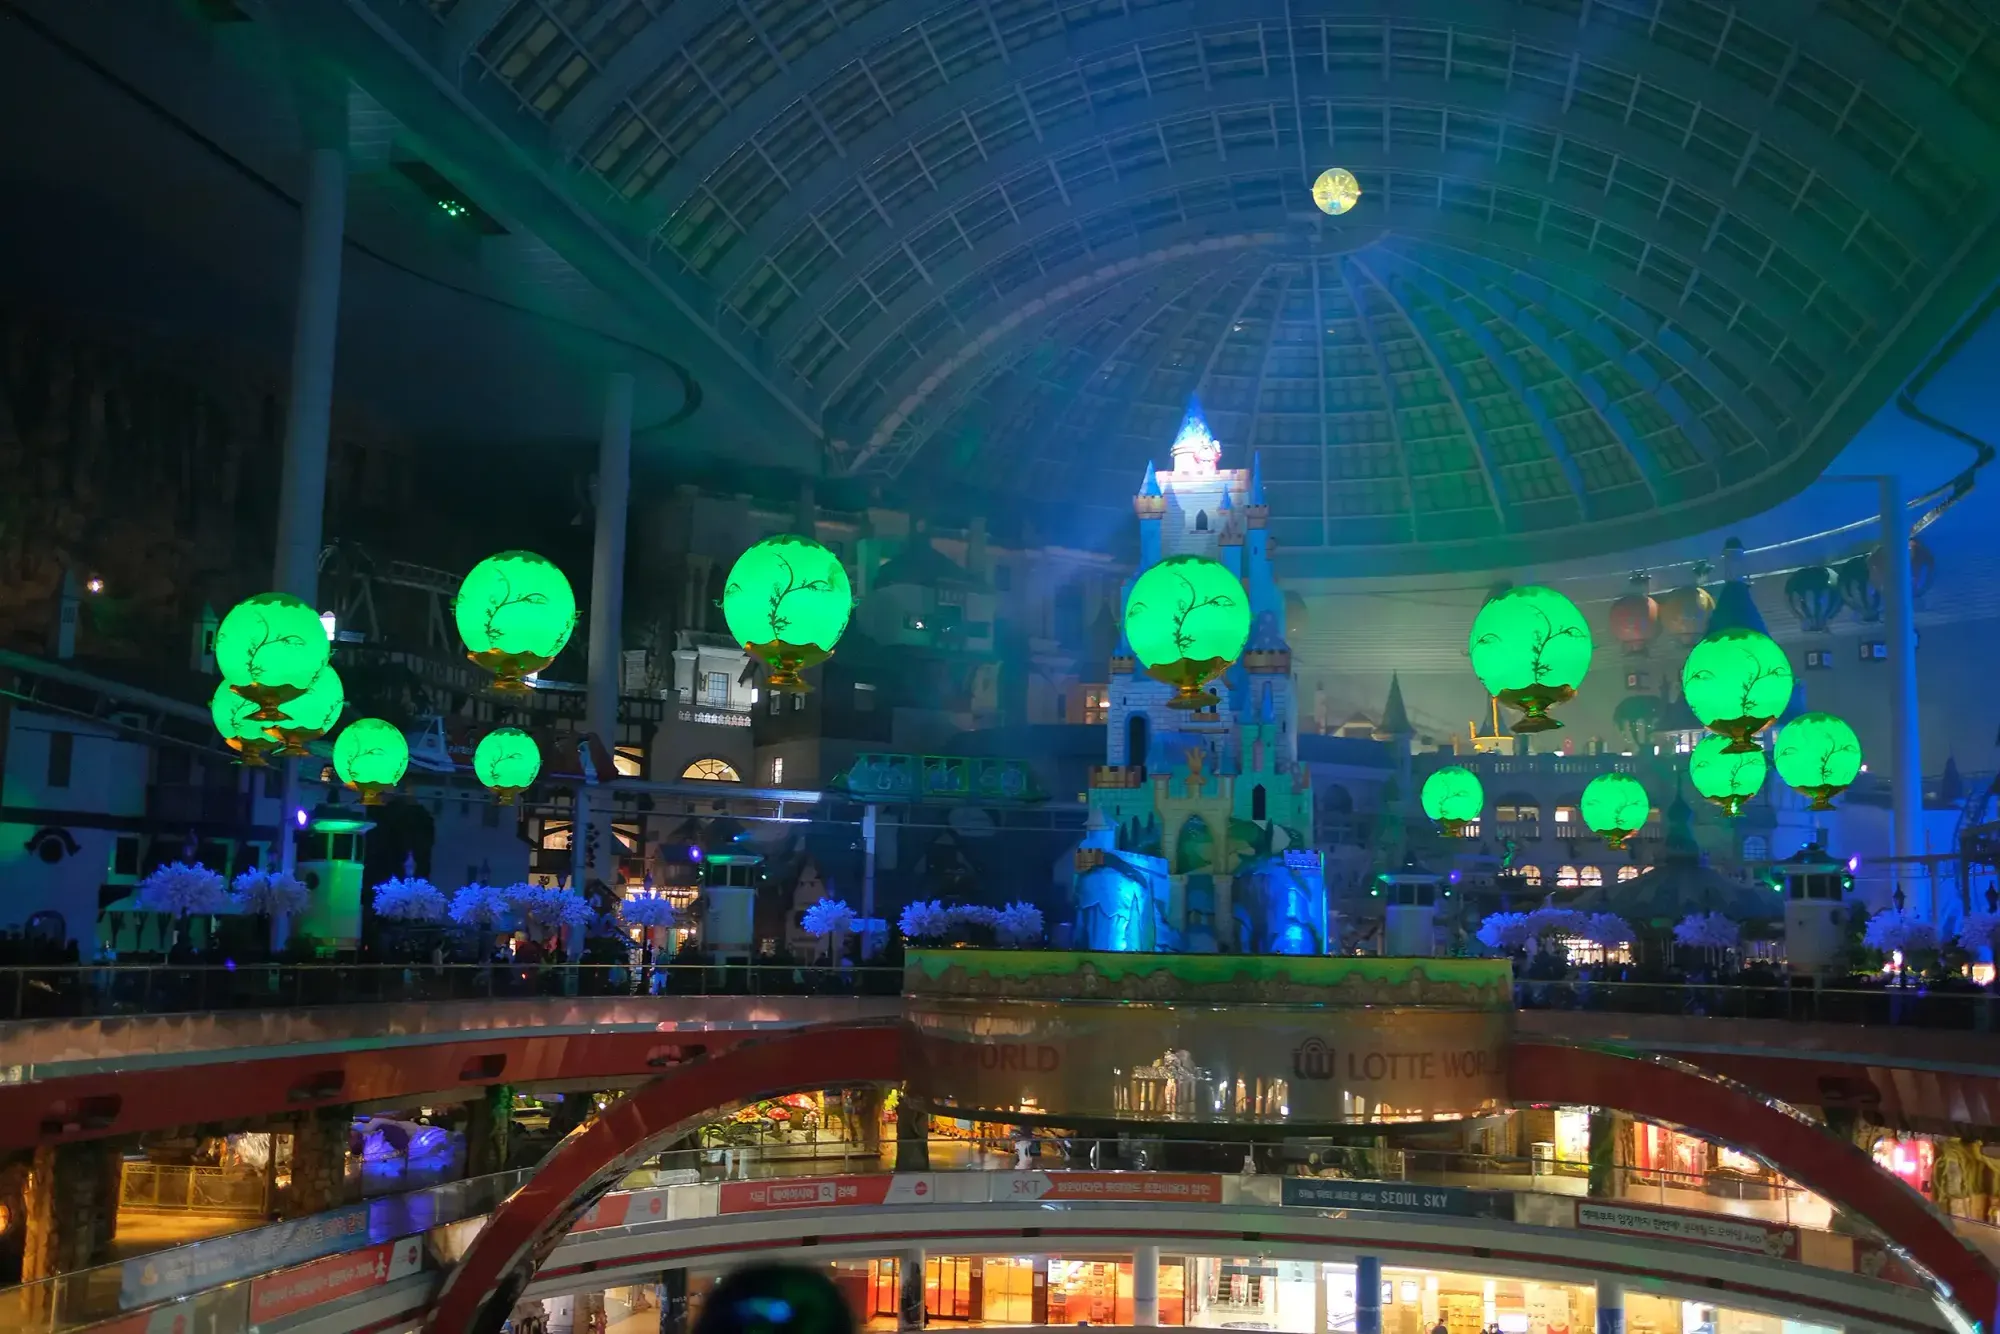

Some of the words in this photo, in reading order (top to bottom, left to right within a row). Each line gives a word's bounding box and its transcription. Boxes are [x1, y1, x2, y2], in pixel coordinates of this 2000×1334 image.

[1346, 1051, 1435, 1081] LOTTE
[1442, 1049, 1498, 1079] WOR
[1012, 1180, 1041, 1194] SKT
[1381, 1190, 1419, 1206] SEOUL
[1424, 1193, 1448, 1208] SKY
[1617, 1213, 1650, 1227] 입장까지
